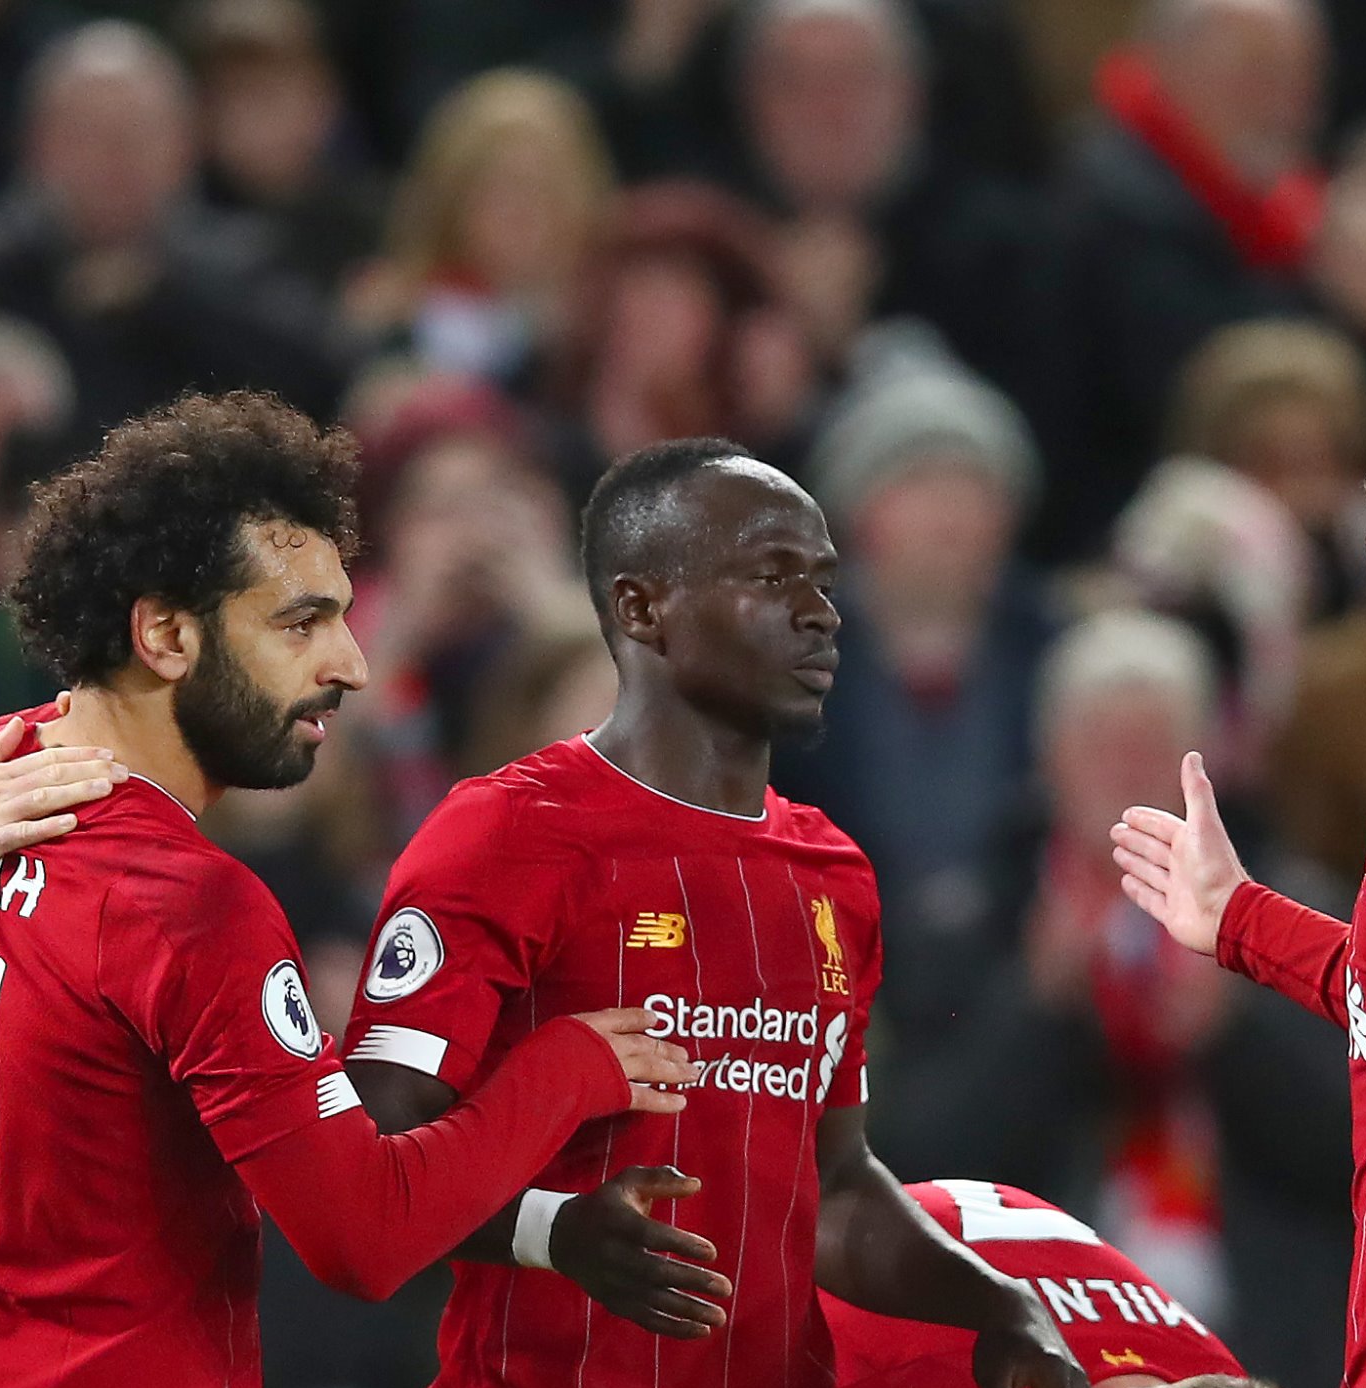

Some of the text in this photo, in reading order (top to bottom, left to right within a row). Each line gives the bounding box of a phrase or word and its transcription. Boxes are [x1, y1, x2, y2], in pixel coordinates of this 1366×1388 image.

[822, 971, 849, 995] LFC
[643, 993, 818, 1046] Standard
[629, 1052, 809, 1100] rtered
